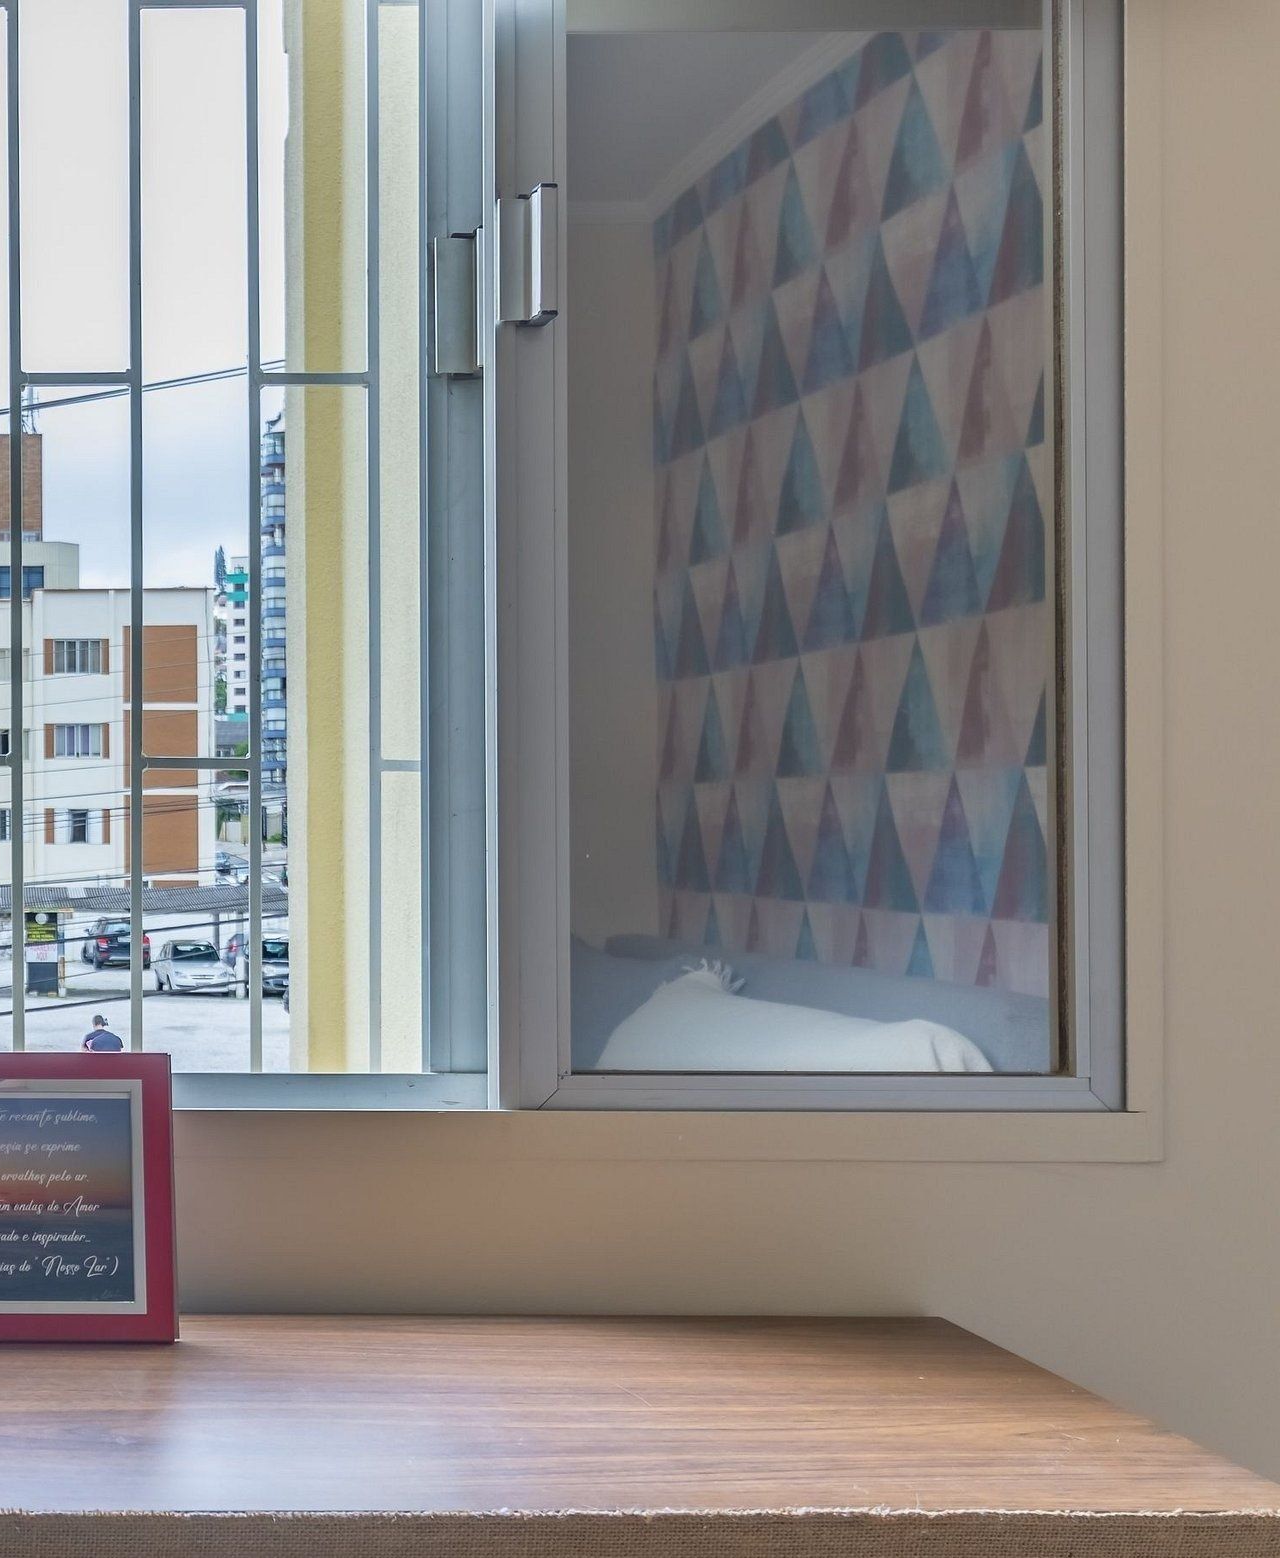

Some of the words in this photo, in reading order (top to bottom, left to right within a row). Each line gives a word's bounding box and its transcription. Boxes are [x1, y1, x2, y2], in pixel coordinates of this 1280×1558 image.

[8, 1108, 55, 1128] recanto
[53, 1110, 99, 1126] sublime,
[24, 1143, 38, 1155] se
[40, 1141, 82, 1158] exprime
[0, 1168, 45, 1185] orvalhos
[45, 1169, 71, 1188] pelo
[13, 1200, 43, 1215] ondas
[63, 1195, 101, 1218] Amor
[21, 1233, 30, 1242] e
